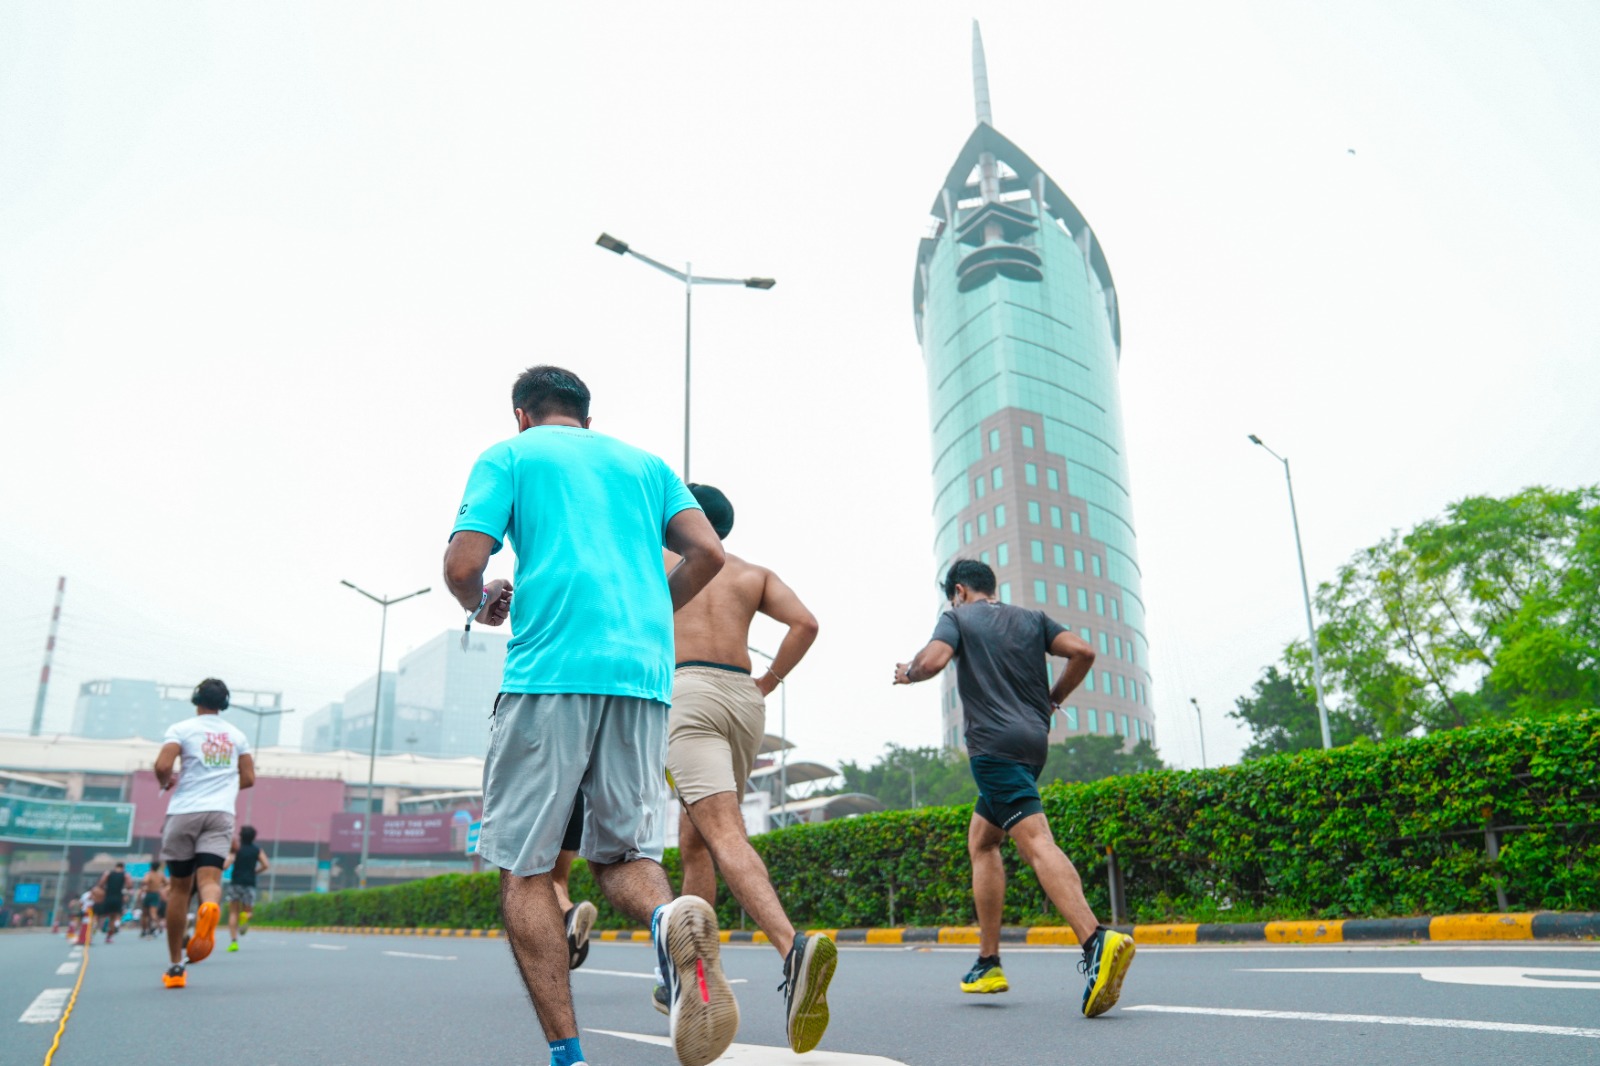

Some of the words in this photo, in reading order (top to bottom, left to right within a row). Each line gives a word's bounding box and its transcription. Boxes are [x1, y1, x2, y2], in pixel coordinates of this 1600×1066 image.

[458, 503, 469, 516] C
[205, 731, 229, 743] THE
[201, 740, 234, 754] GOAT
[204, 753, 231, 766] RUN
